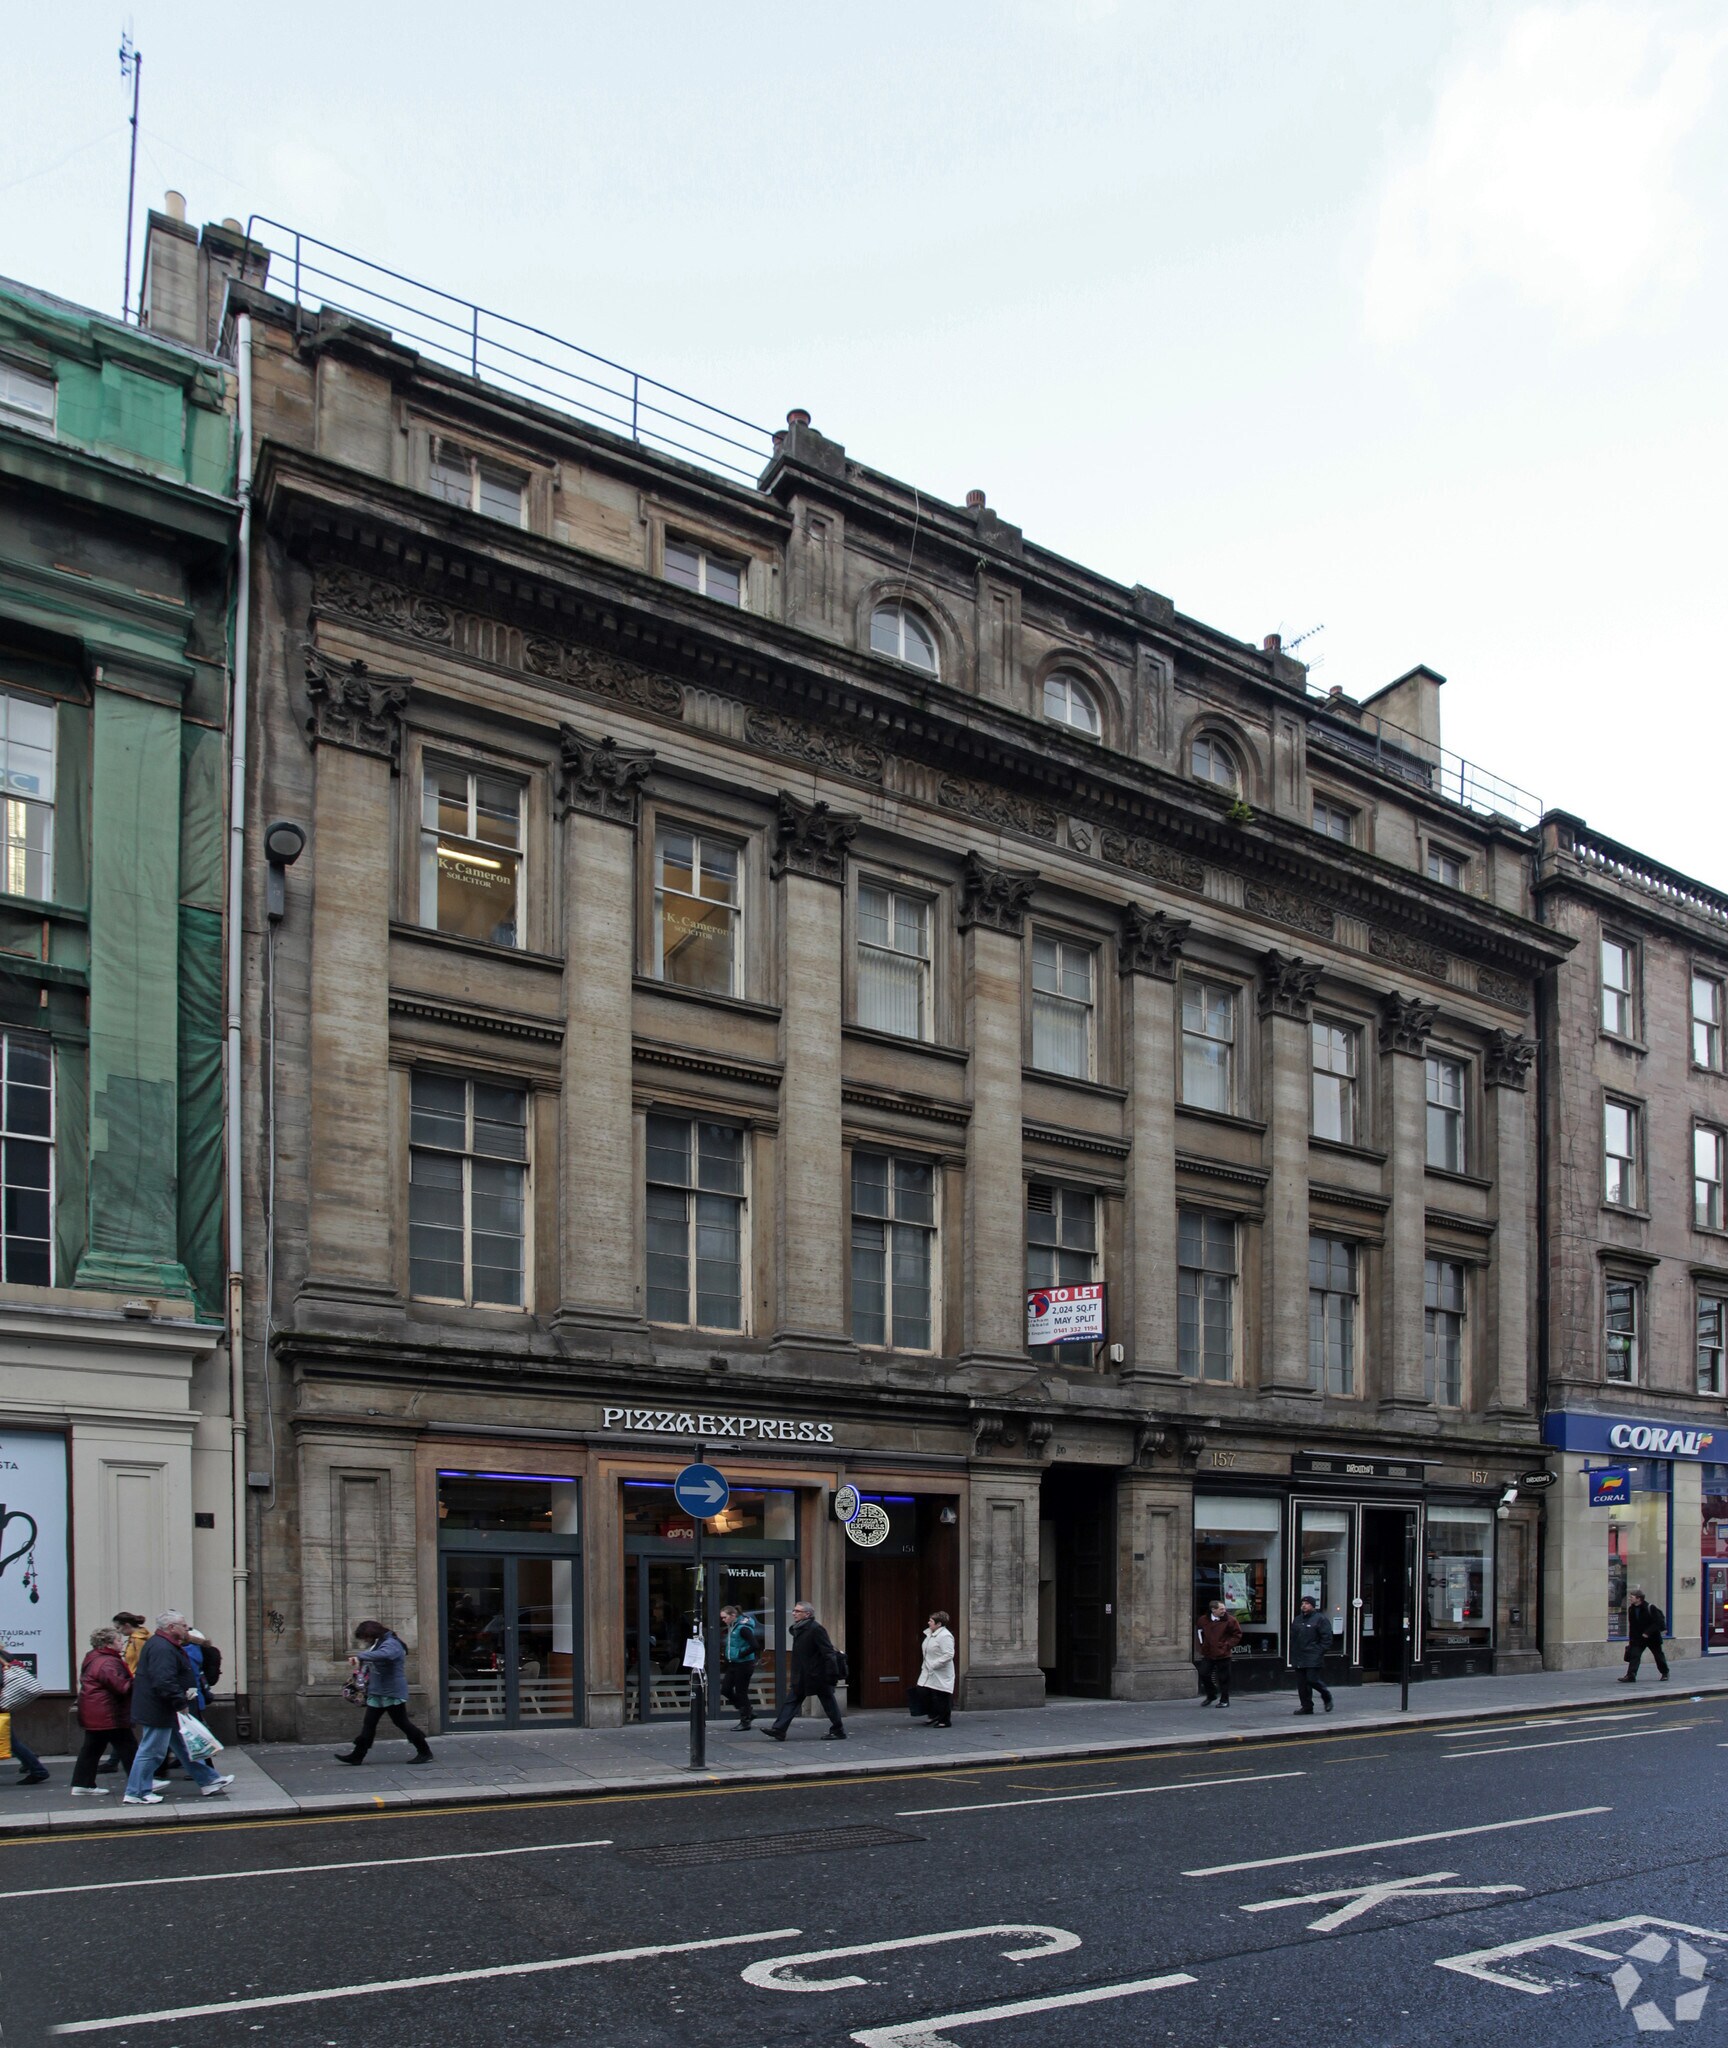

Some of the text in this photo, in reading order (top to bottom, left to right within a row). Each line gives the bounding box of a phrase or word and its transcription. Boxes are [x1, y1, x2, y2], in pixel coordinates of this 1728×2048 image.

[446, 872, 492, 888] SOLICITOR
[455, 863, 511, 885] Cameron
[674, 926, 713, 940] SOLICITOR
[681, 916, 729, 936] Cameron
[1049, 1286, 1099, 1302] TO LET
[1052, 1303, 1097, 1315] 2,024 SQ.FT
[1054, 1314, 1096, 1325] MAY SPLIT
[1610, 1424, 1699, 1455] CORAL
[1212, 1452, 1236, 1468] 157
[1470, 1471, 1489, 1484] 157
[1593, 1494, 1625, 1503] CORAL
[727, 1568, 767, 1578] Wi-Fi Area
